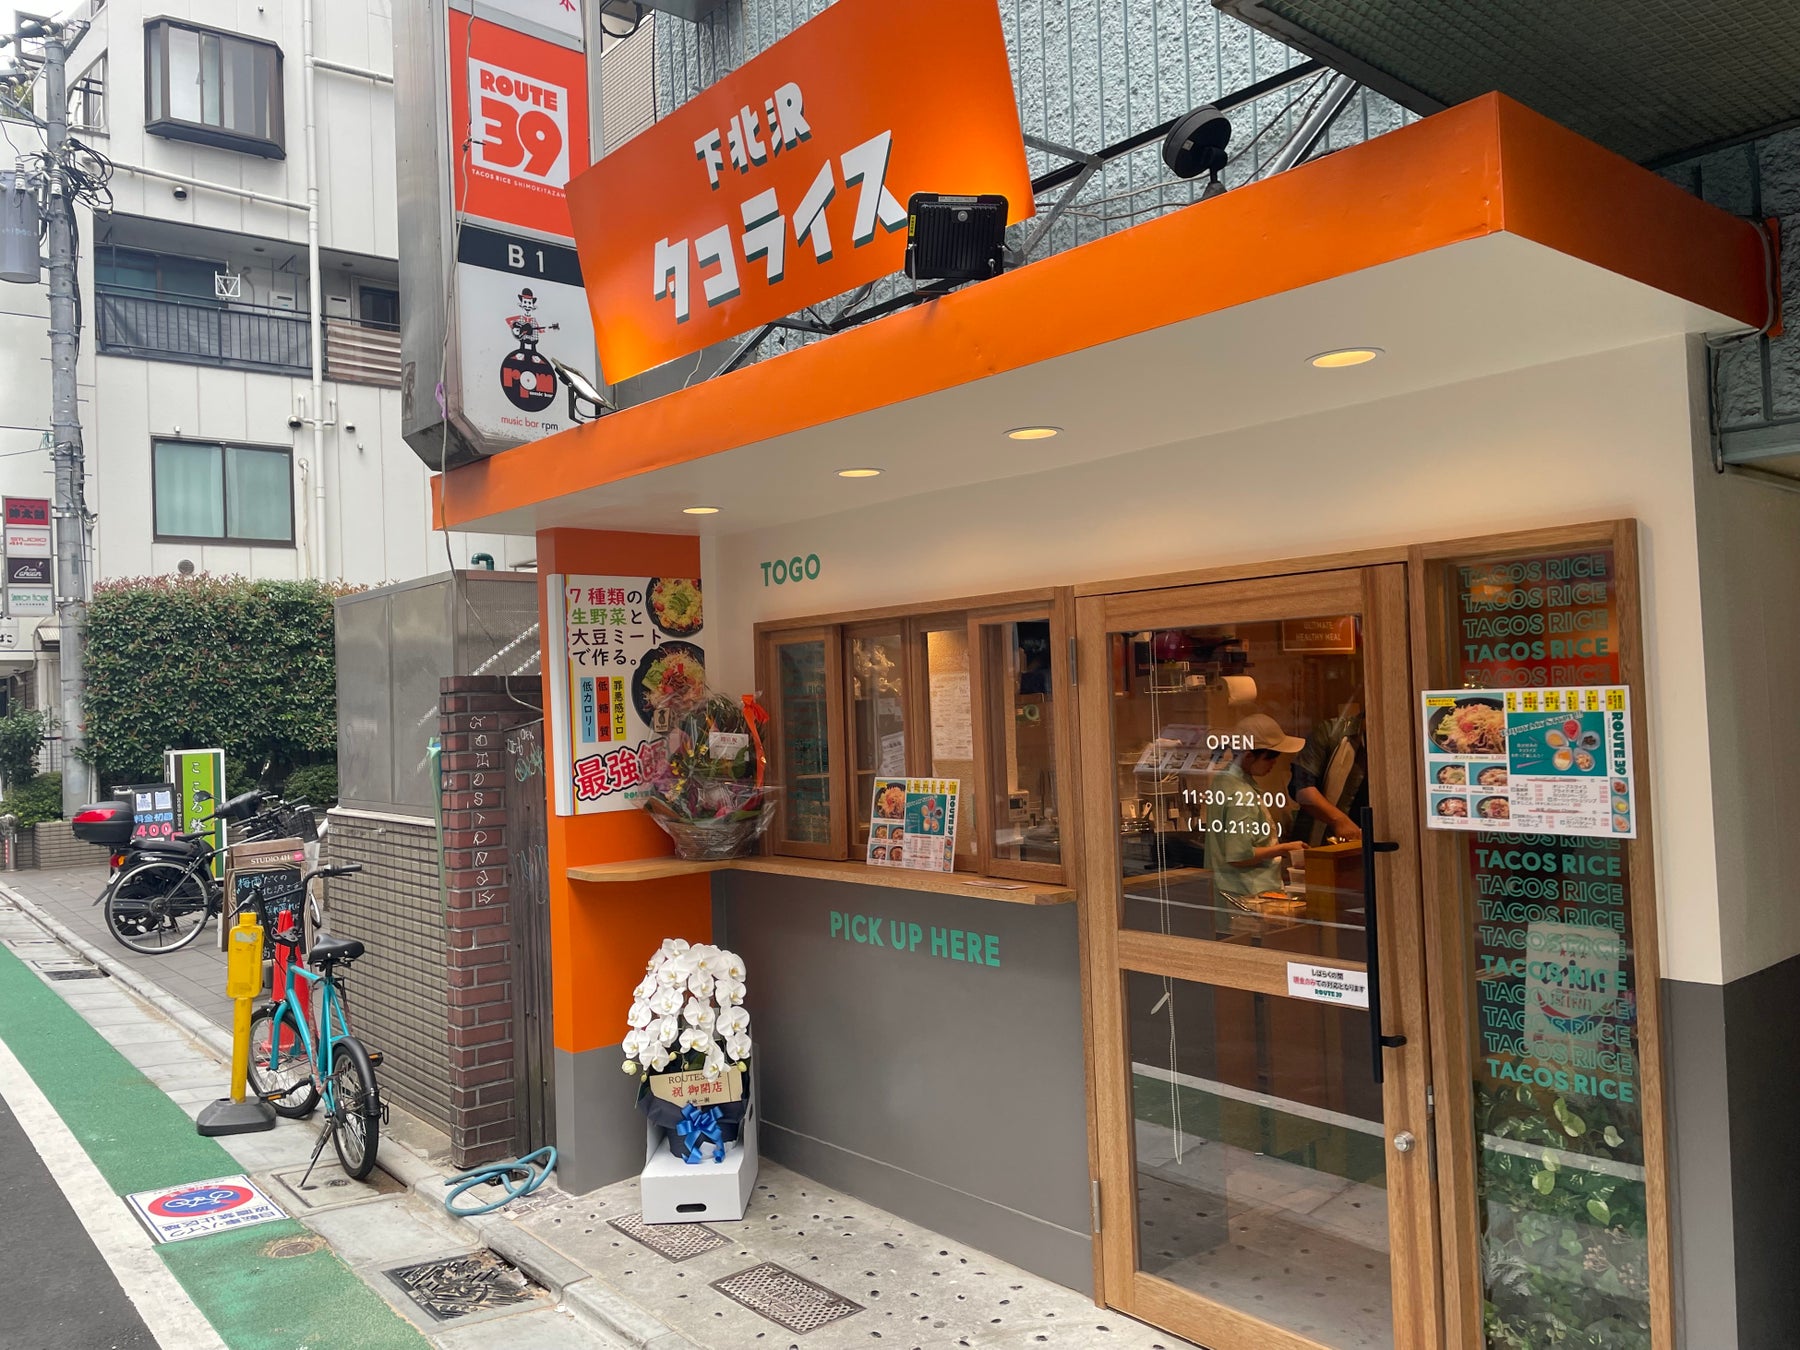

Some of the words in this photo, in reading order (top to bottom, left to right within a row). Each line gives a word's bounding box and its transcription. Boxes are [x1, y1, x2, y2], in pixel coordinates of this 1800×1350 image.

[479, 68, 558, 112] ROUTE
[480, 96, 563, 178] 39
[694, 81, 812, 191] 下北沢
[471, 169, 495, 180] TACOS
[495, 175, 511, 185] RICE
[653, 129, 908, 325] タコライス
[500, 415, 524, 427] music
[524, 416, 539, 428] bar
[541, 421, 559, 433] rpm
[760, 553, 821, 587] TOGO
[1546, 554, 1606, 581] RICE
[569, 587, 643, 606] 7種類の
[1461, 587, 1543, 613] TACOS
[1547, 581, 1607, 607] RICE
[571, 608, 643, 626] 生野菜と
[1463, 613, 1545, 639] TACOS
[1548, 609, 1609, 634] RICE
[571, 628, 663, 647] 大豆ミート
[1464, 641, 1545, 663] TACOS
[1550, 637, 1610, 660] RICE
[572, 648, 639, 667] で作る。
[582, 680, 593, 738] 低カロリー
[597, 681, 609, 738] 低糖質
[613, 680, 625, 736] 罪悪感ゼロ
[1206, 734, 1255, 750] OPEN
[1612, 711, 1625, 759] ROUTE
[1614, 759, 1627, 776] 39
[1182, 789, 1286, 808] 11:30-22:00
[250, 857, 279, 865] STUDIO
[1475, 849, 1557, 873] TACOS
[1561, 853, 1622, 877] RICE
[1476, 874, 1559, 899] TACOS
[1562, 880, 1625, 905] RICE
[1477, 900, 1561, 925] TACOS
[1563, 908, 1626, 934] RICE
[830, 911, 884, 946] PICK
[890, 920, 923, 952] UP
[930, 926, 1000, 967] HERE
[1479, 926, 1564, 954] TACOS
[1481, 954, 1563, 982] TACOS
[1568, 964, 1628, 991] RICE
[1570, 1019, 1631, 1048] RICE
[1484, 1032, 1568, 1065] TACOS
[1572, 1045, 1633, 1076] RICE
[1486, 1058, 1569, 1091] TACOS
[1574, 1074, 1633, 1103] RICE
